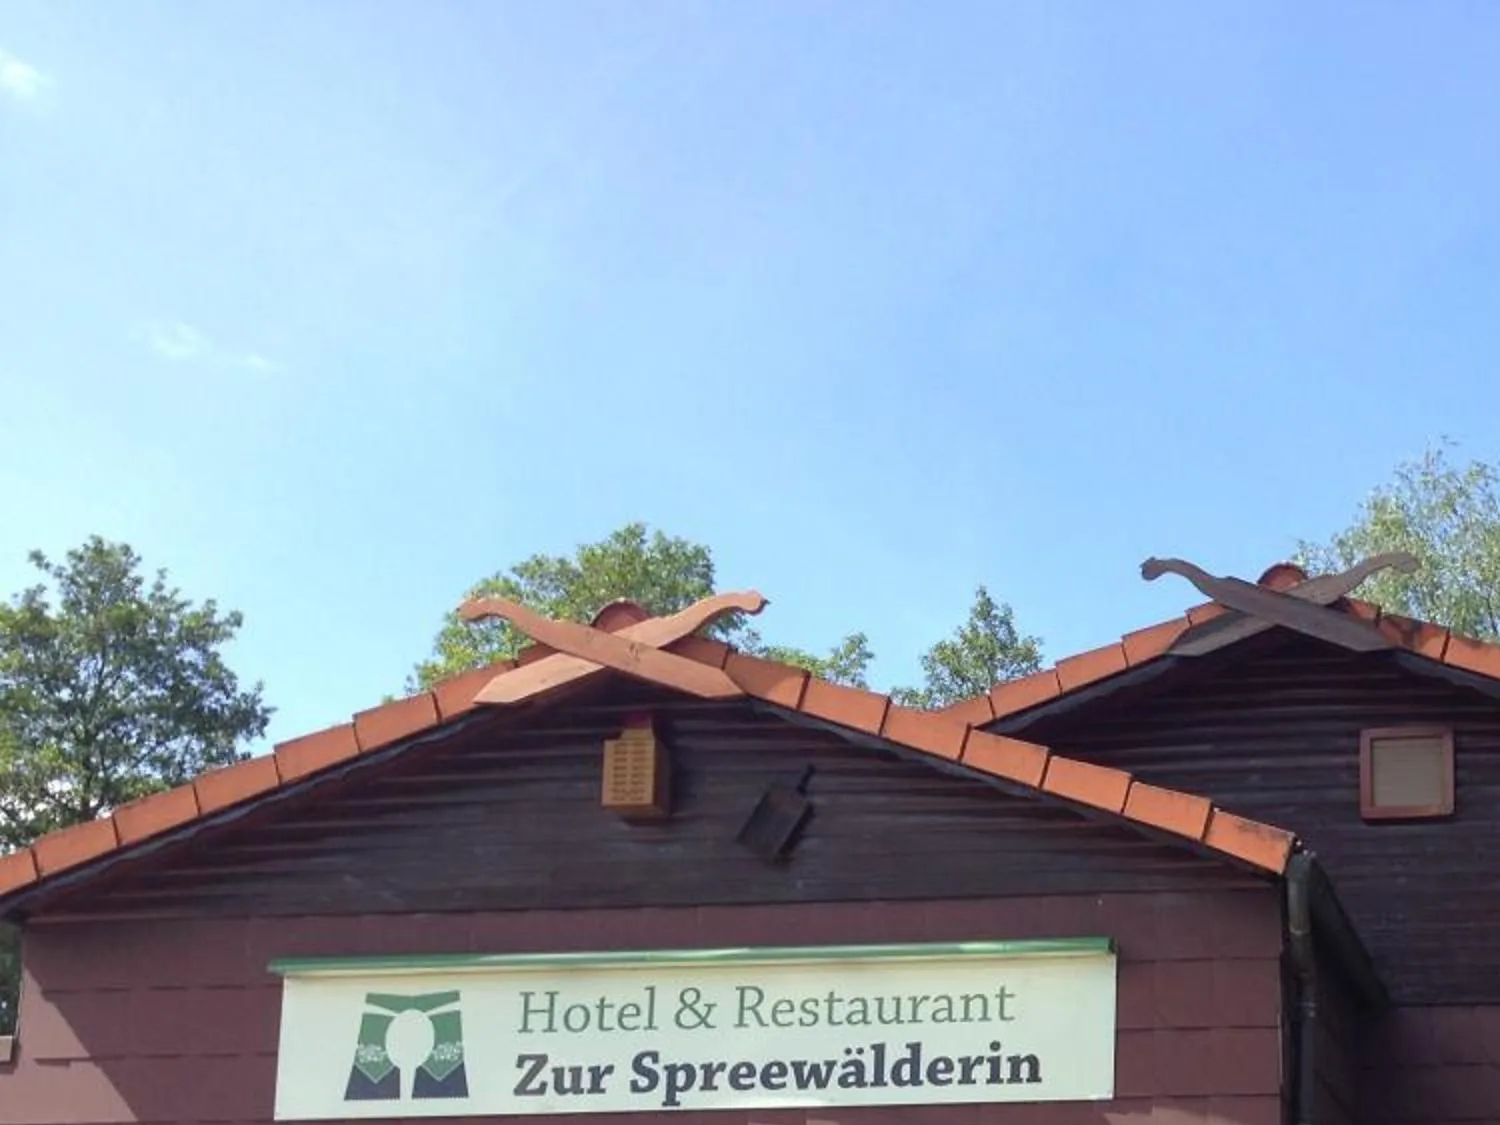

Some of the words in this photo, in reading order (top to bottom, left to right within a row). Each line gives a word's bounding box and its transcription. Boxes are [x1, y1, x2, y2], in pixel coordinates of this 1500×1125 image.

[517, 985, 659, 1034] Hotel
[674, 987, 717, 1031] &
[733, 984, 1016, 1030] Restaurant
[513, 1053, 615, 1097] Zur
[629, 1040, 1042, 1107] Spreewälderin
